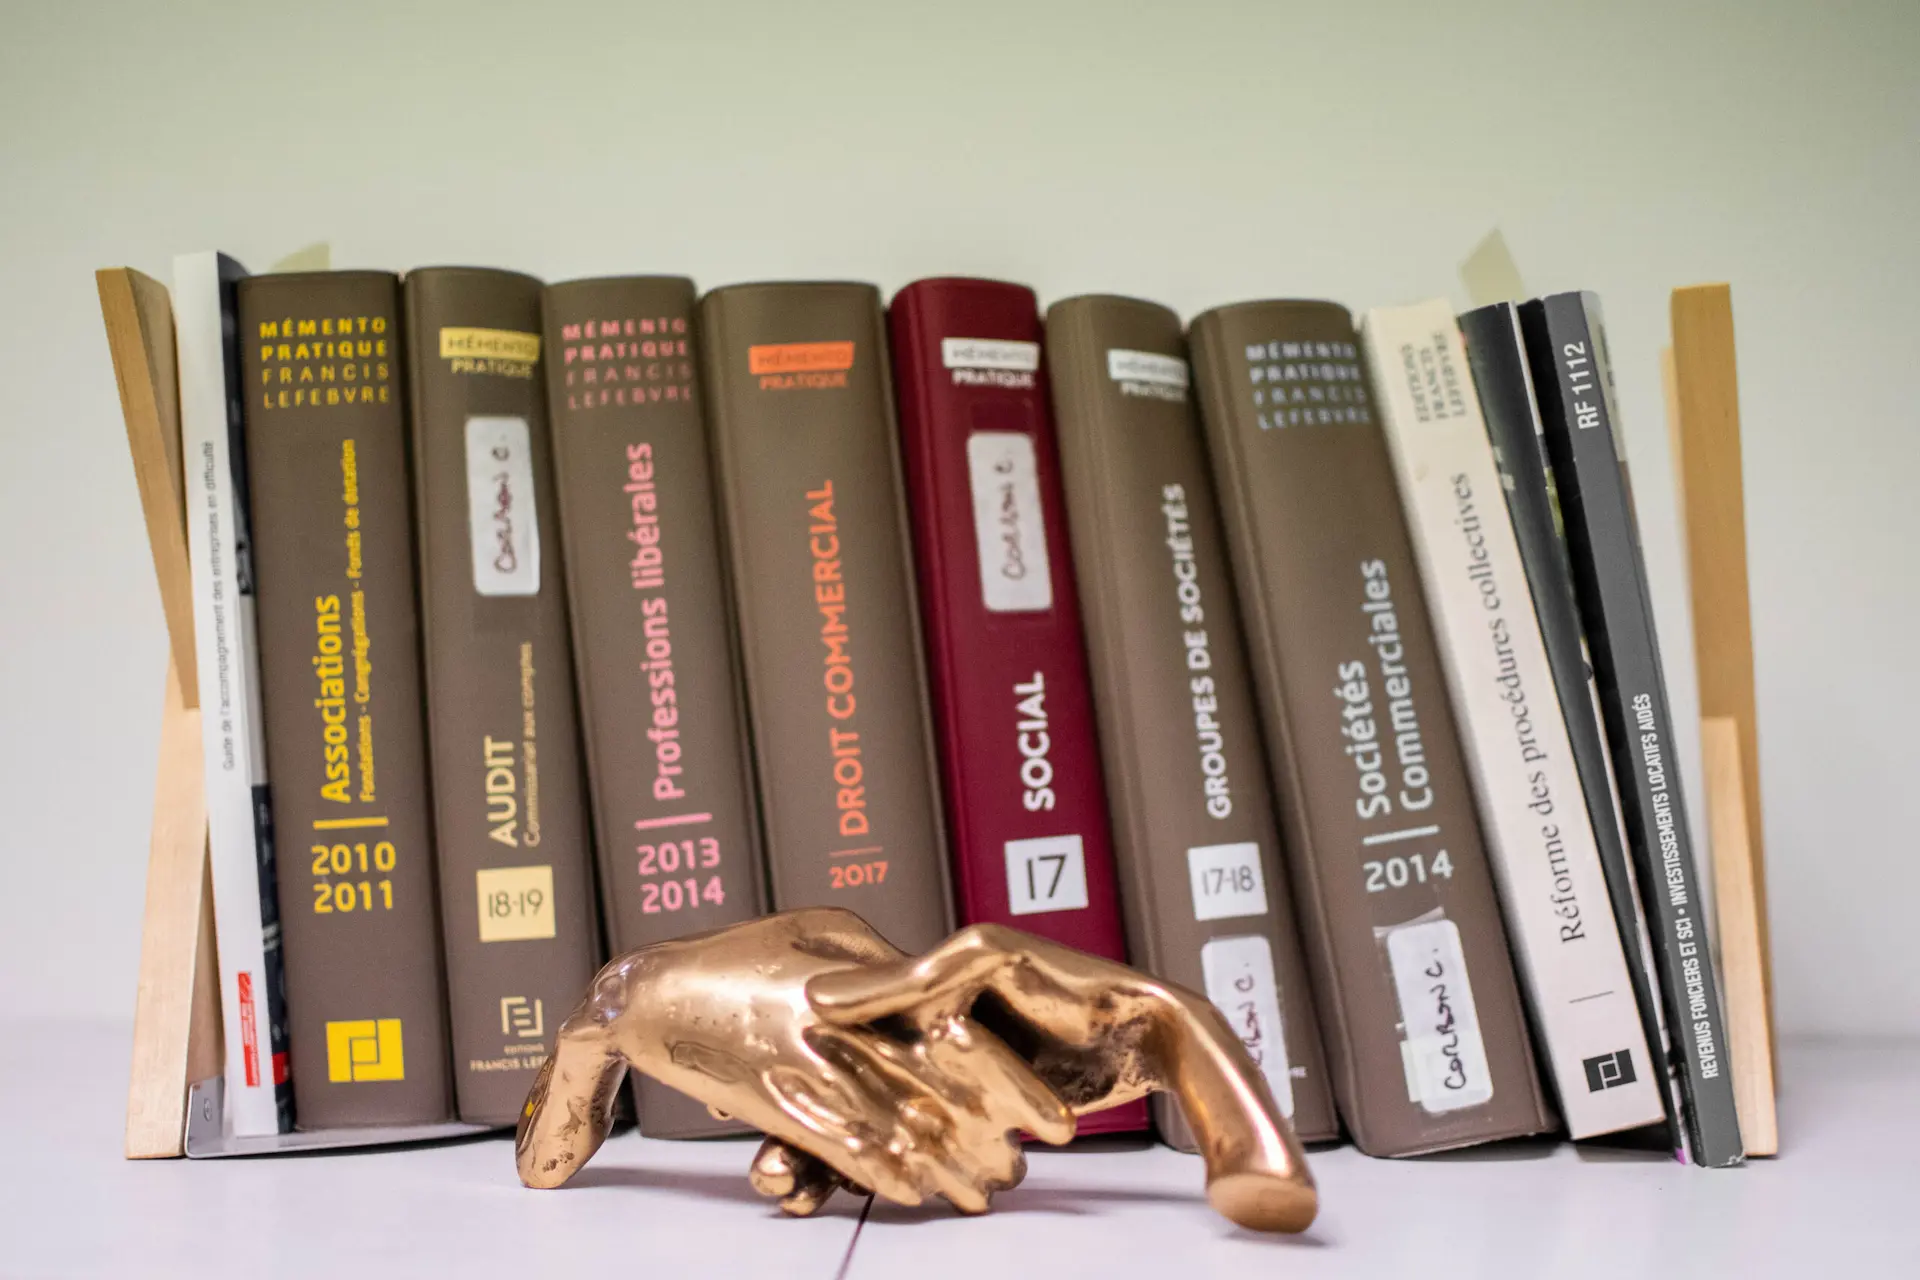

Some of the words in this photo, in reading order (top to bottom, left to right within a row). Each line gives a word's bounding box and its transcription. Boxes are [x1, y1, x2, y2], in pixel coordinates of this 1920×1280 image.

[260, 317, 386, 338] MÉMENTO
[562, 317, 686, 341] MÉMENTO
[261, 340, 387, 361] PRATIQUE
[451, 357, 534, 380] PRATIQUE
[564, 339, 687, 366] PRATIQUE
[1245, 339, 1357, 361] MÉMENTO
[1563, 341, 1593, 395] 1112
[262, 363, 388, 385] FRANCIS
[566, 361, 692, 388] FRANCIS
[760, 371, 848, 391] PRATIQUE
[951, 368, 1035, 390] PRATIQUE
[1249, 363, 1361, 385] PRATIQUE
[263, 386, 389, 410] LEFEBVRE
[1577, 401, 1599, 430] RF
[202, 440, 217, 491] difficulté
[340, 439, 360, 505] dotation
[207, 495, 218, 509] en
[344, 507, 361, 529] de
[624, 442, 665, 590] libérales
[208, 513, 222, 577] entreprises
[346, 530, 362, 579] Fonds
[1163, 484, 1202, 622] SOCIÉTÉS
[1450, 472, 1502, 611] collectives
[212, 580, 223, 602] des
[806, 480, 857, 720] COMMERCIAL
[350, 590, 372, 703] Congrégations
[1186, 629, 1212, 670] DE
[520, 641, 538, 709] comptes
[1361, 558, 1434, 812] Commerciales
[1486, 618, 1547, 763] procédures
[312, 594, 352, 804] Associations
[641, 597, 685, 800] Professions
[1631, 692, 1657, 731] AIDÉS
[221, 719, 233, 733] de
[522, 710, 537, 739] aux
[1014, 671, 1055, 811] SOCIAL
[1334, 659, 1391, 820] Sociétés
[222, 737, 236, 771] Guide
[357, 714, 376, 803] Fondations
[1194, 675, 1233, 819] GROUPES
[1642, 732, 1668, 791] LOCATIFS
[484, 735, 519, 848] AUDIT
[829, 726, 870, 837] DROIT
[1524, 770, 1554, 817] des
[311, 842, 396, 876] 2010
[637, 837, 721, 877] 2013
[1653, 792, 1689, 906] INVESTISSEMENTS
[829, 860, 889, 890] 2017
[1026, 854, 1067, 901] 17
[1364, 850, 1454, 893] 2014
[1537, 824, 1587, 943] Réforme
[313, 880, 393, 914] 2011
[641, 876, 726, 915] 2014
[1674, 917, 1695, 940] SCI
[1678, 941, 1697, 957] ET
[1681, 957, 1709, 1019] FONCIERS
[469, 1058, 521, 1072] FRANCIS
[1692, 1020, 1720, 1079] REVENUS
